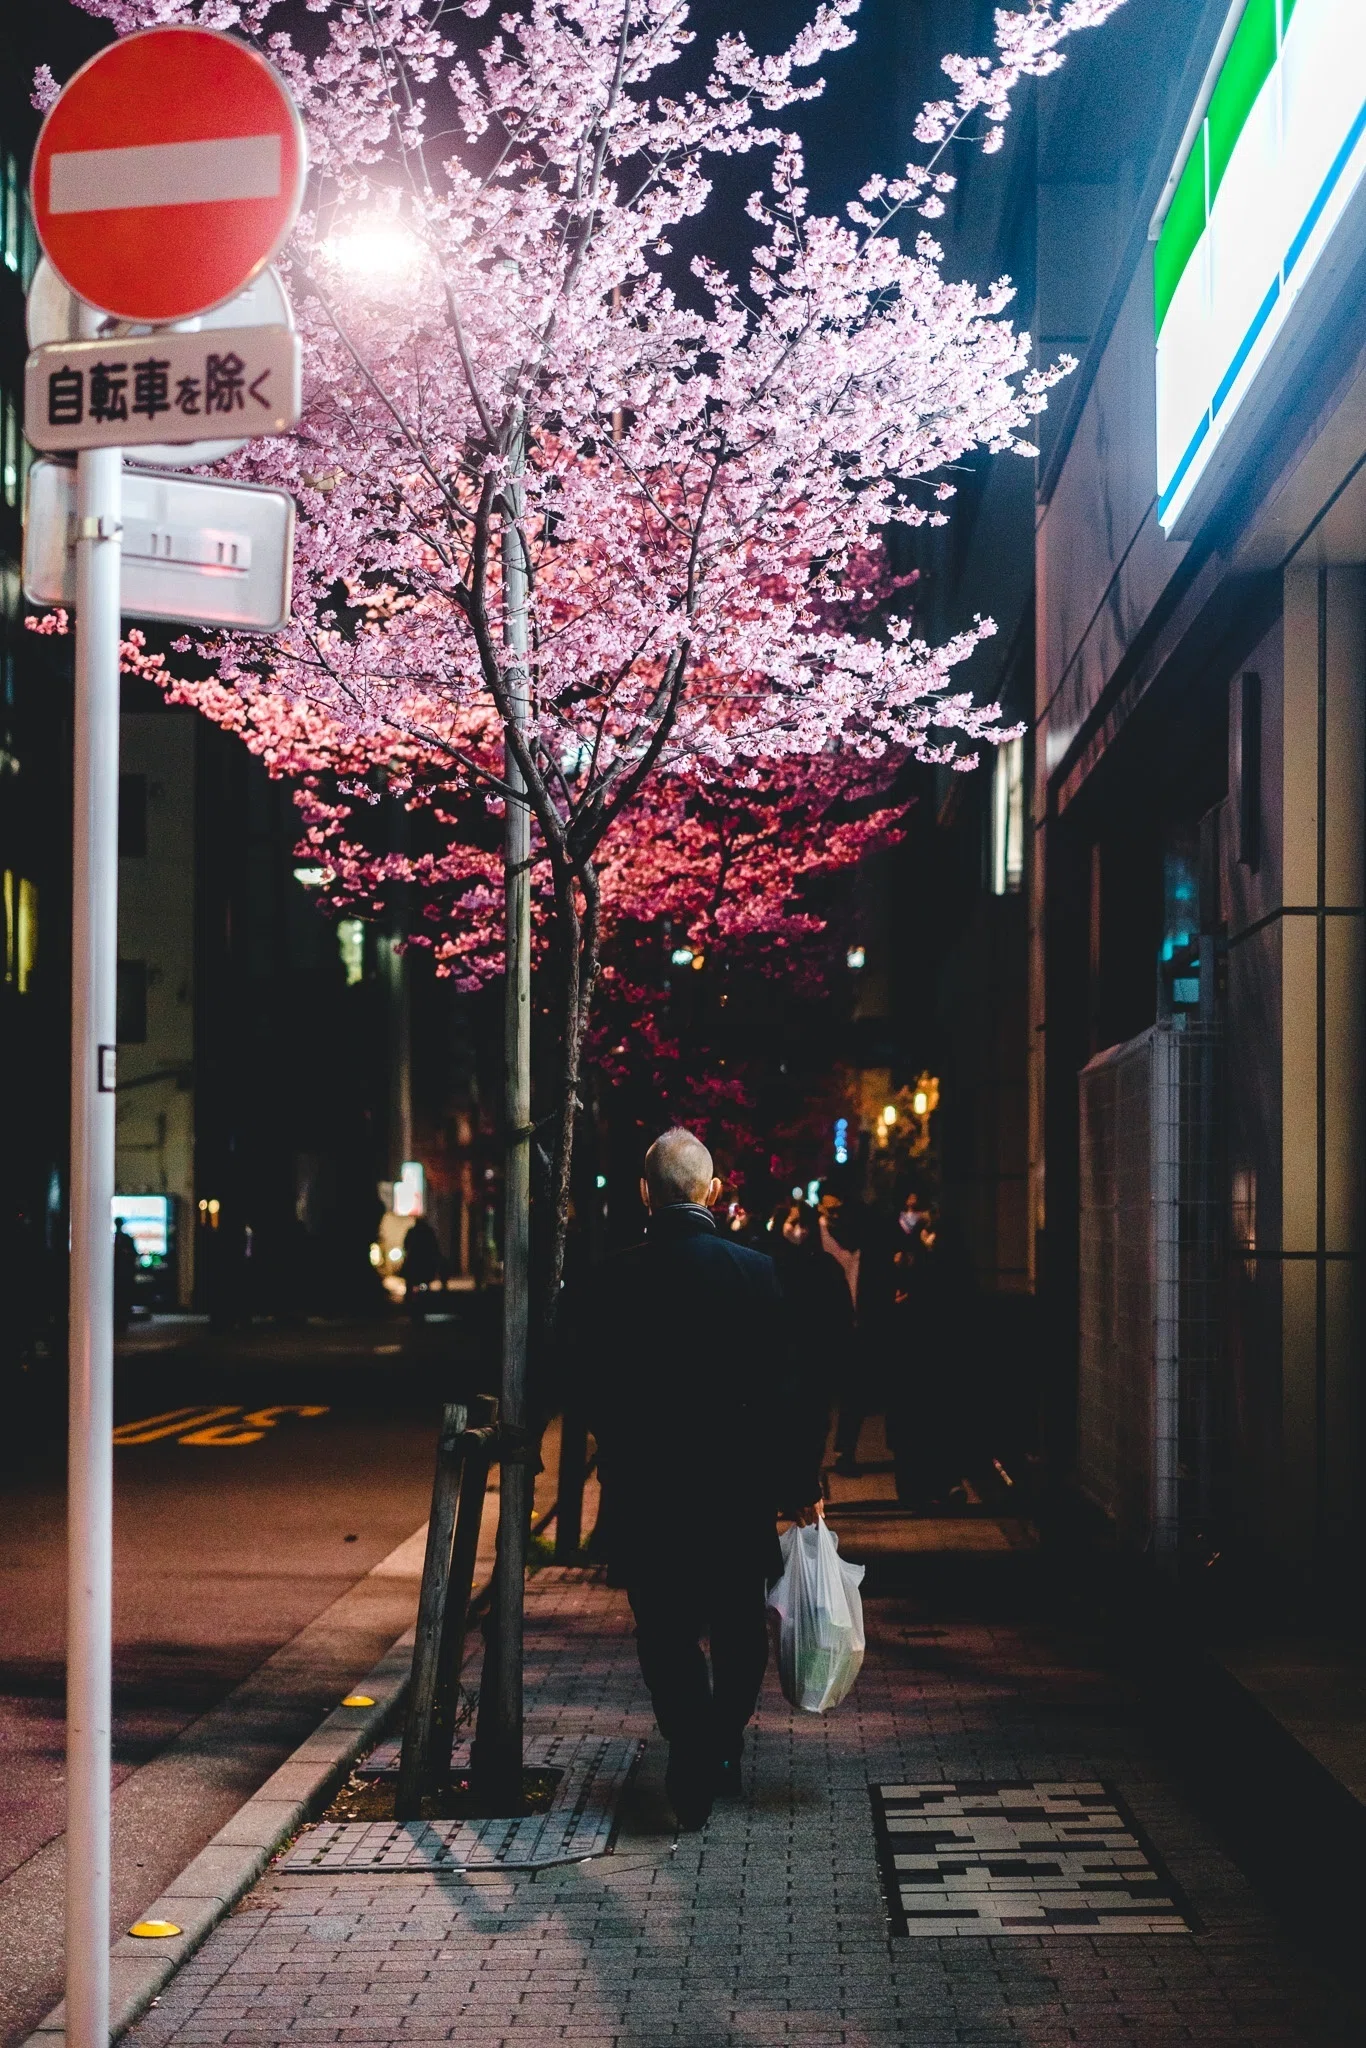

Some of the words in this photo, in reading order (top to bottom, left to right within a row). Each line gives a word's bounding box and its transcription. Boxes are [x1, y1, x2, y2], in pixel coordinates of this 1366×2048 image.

[48, 352, 271, 424] 自転車を除く
